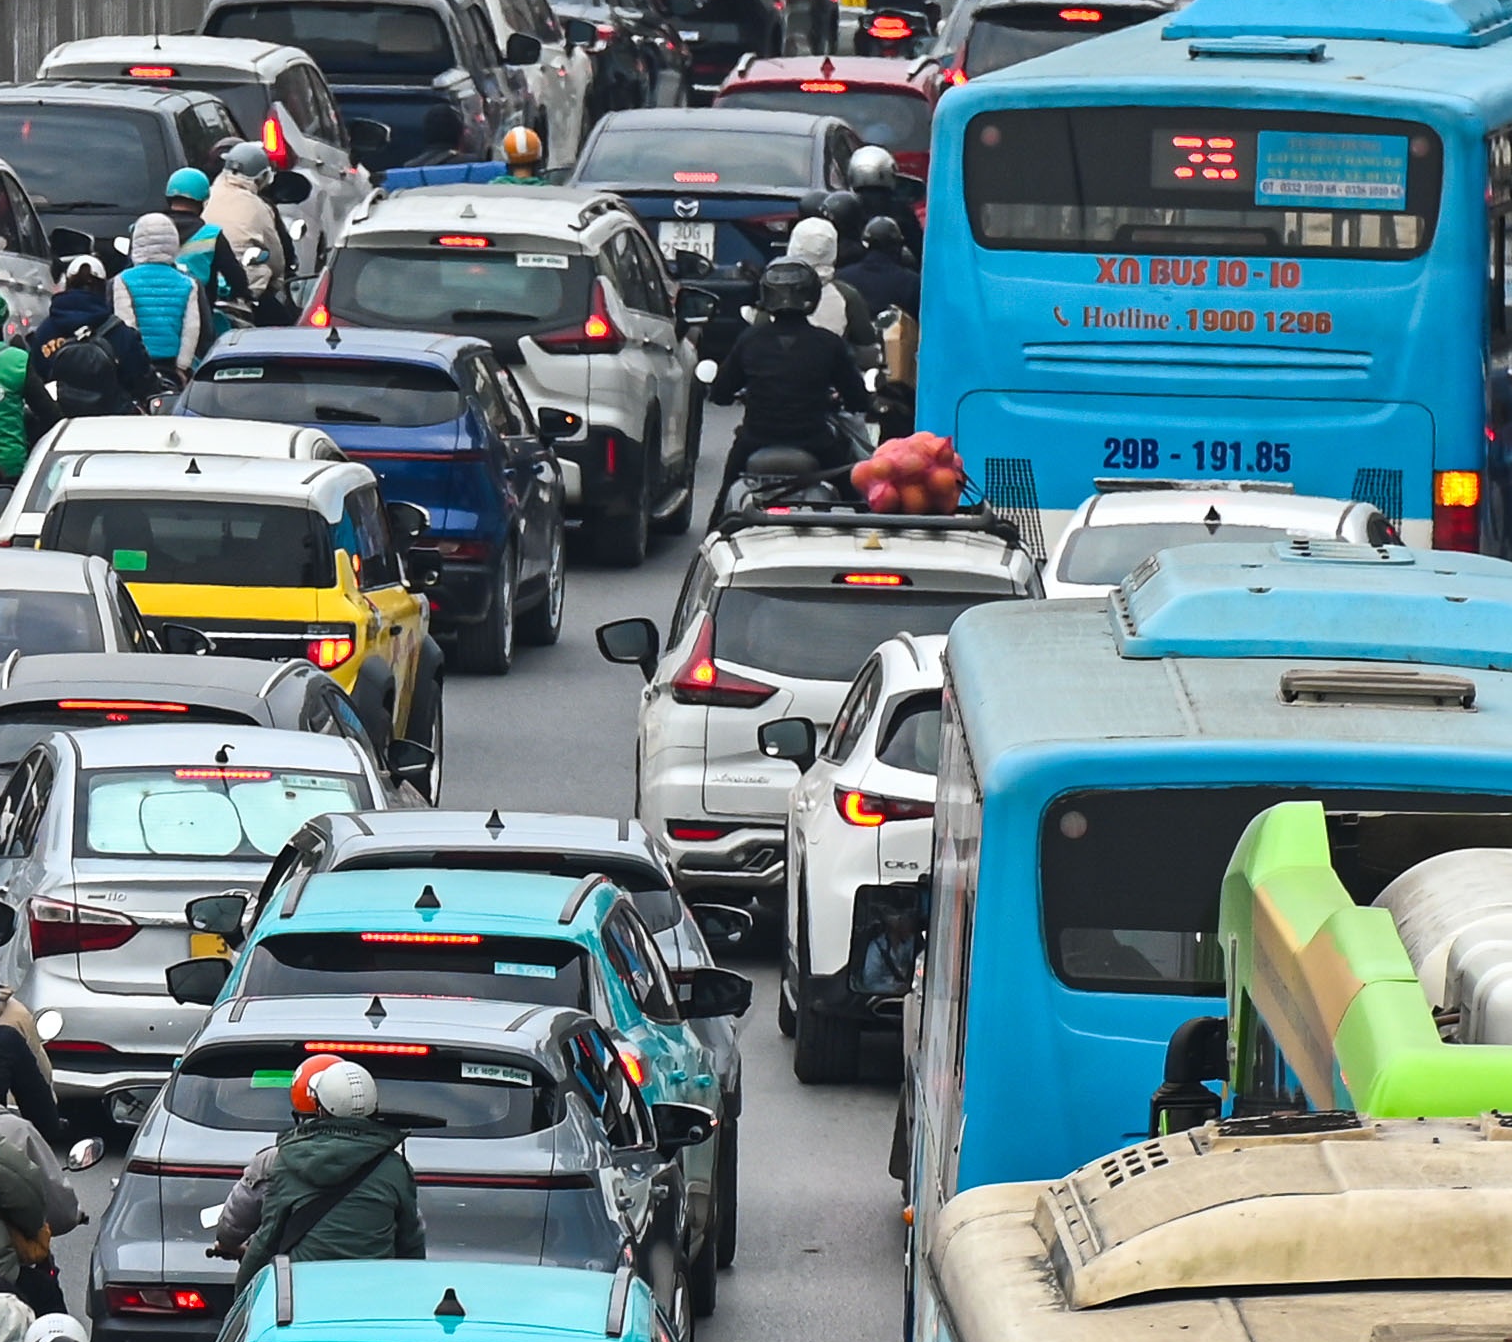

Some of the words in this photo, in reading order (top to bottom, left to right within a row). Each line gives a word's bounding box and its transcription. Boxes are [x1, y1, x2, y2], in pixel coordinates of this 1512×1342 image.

[1150, 258, 1208, 286] BUS
[1083, 306, 1169, 330] Hotline
[1186, 308, 1254, 333] 1900
[1264, 311, 1332, 335] 1296
[1103, 437, 1159, 470] 29B
[1193, 440, 1291, 474] 191.85
[466, 1066, 480, 1075] XE
[502, 1069, 528, 1082] ĐỒNG
